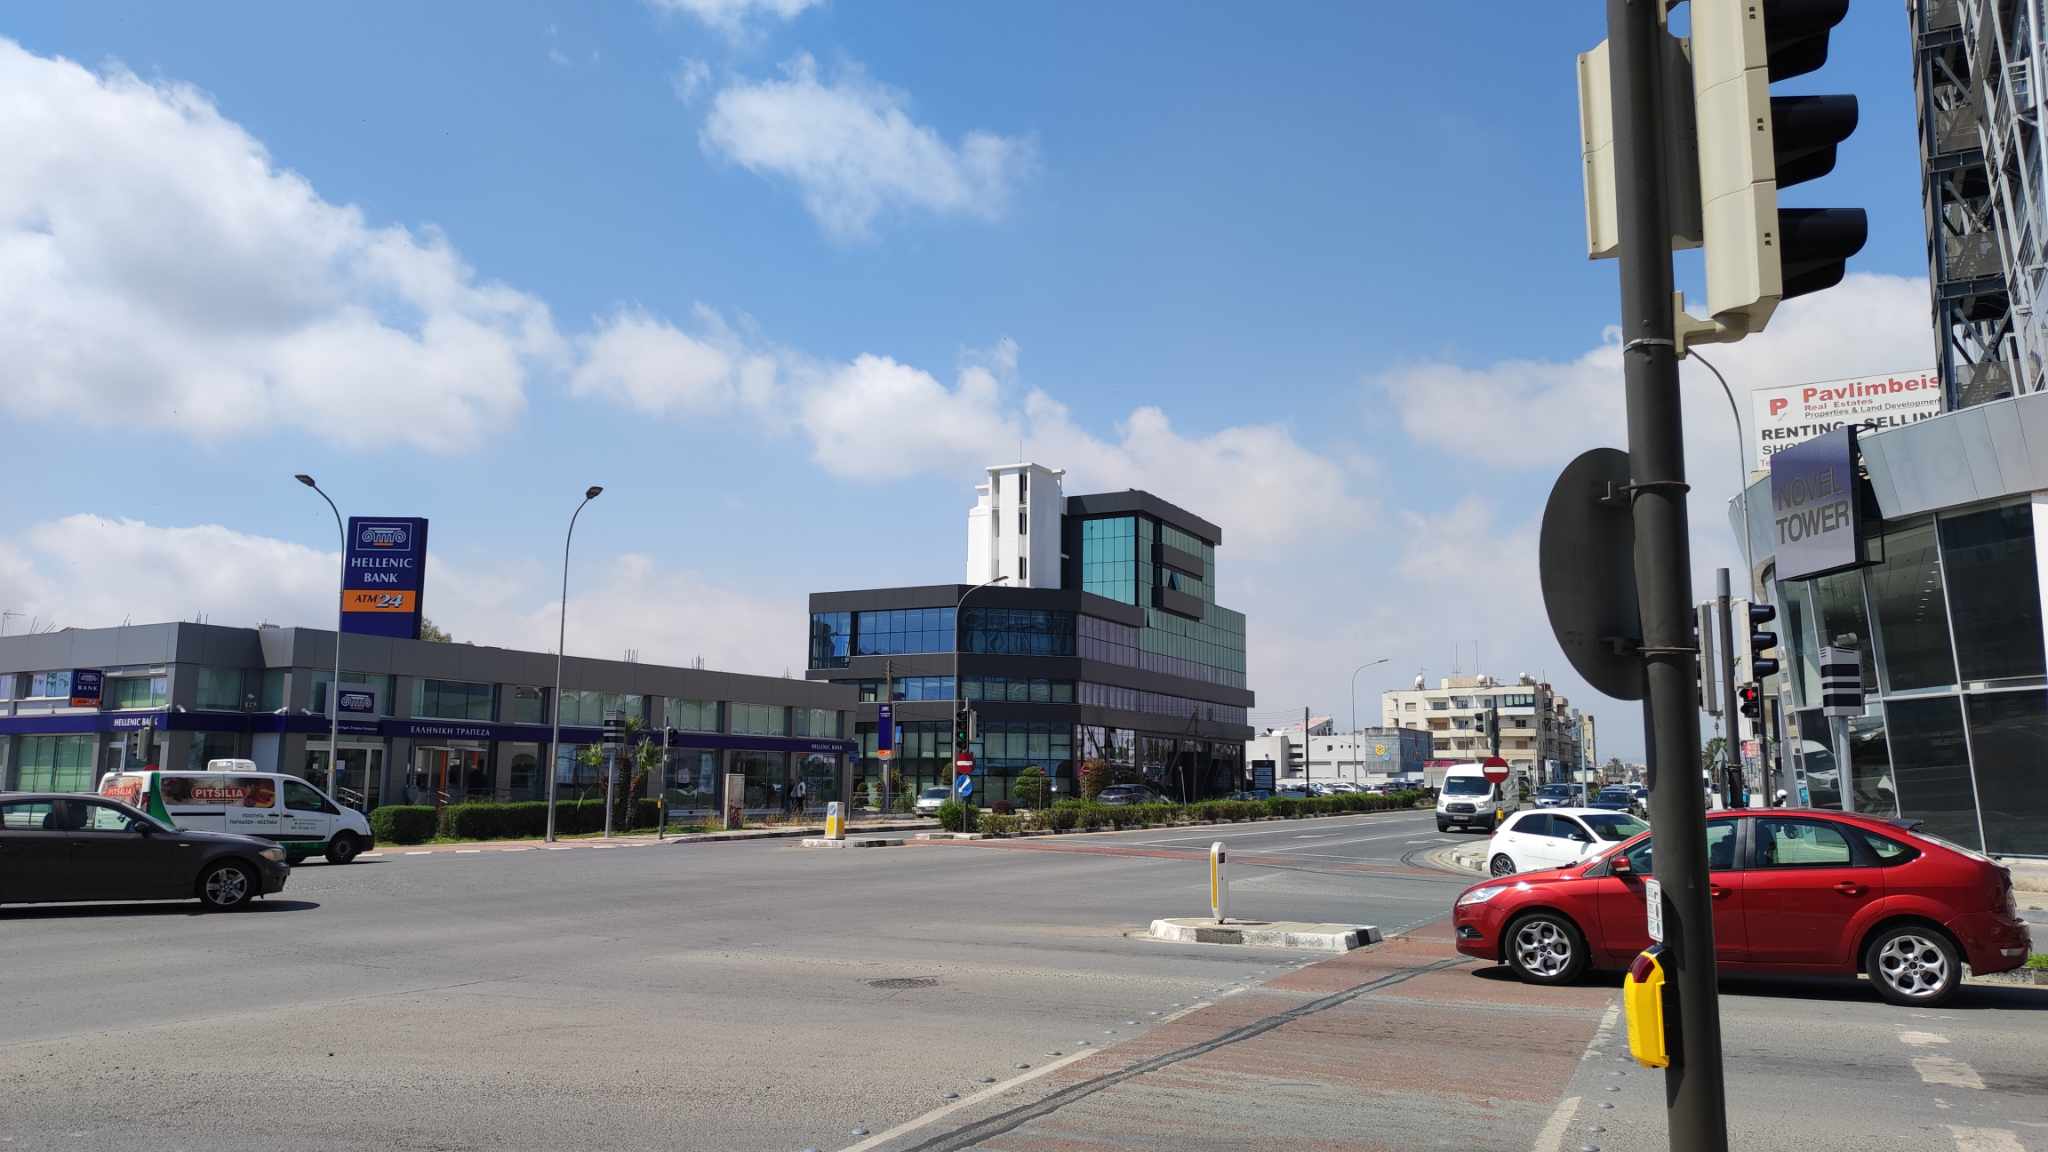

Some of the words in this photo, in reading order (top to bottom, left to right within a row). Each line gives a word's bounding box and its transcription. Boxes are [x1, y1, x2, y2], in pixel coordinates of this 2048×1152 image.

[1802, 374, 1939, 403] Pavlimbeis
[1804, 402, 1827, 411] Real
[1833, 398, 1873, 408] Estates
[1804, 408, 1849, 419] Properties
[1860, 403, 1883, 413] Land
[1884, 398, 1940, 411] Developmen
[1776, 464, 1843, 511] NOVEL
[1775, 501, 1850, 545] TOWER
[351, 557, 414, 568] HELLENIC
[363, 572, 398, 583] BANK
[354, 594, 378, 603] ATM
[113, 718, 141, 727] HELLENIC
[409, 725, 454, 735] ΕΛΛΗΝΙΚΗ
[455, 727, 491, 737] ΤΡΑΠΕΖΑ
[195, 788, 244, 798] PITSILIA
